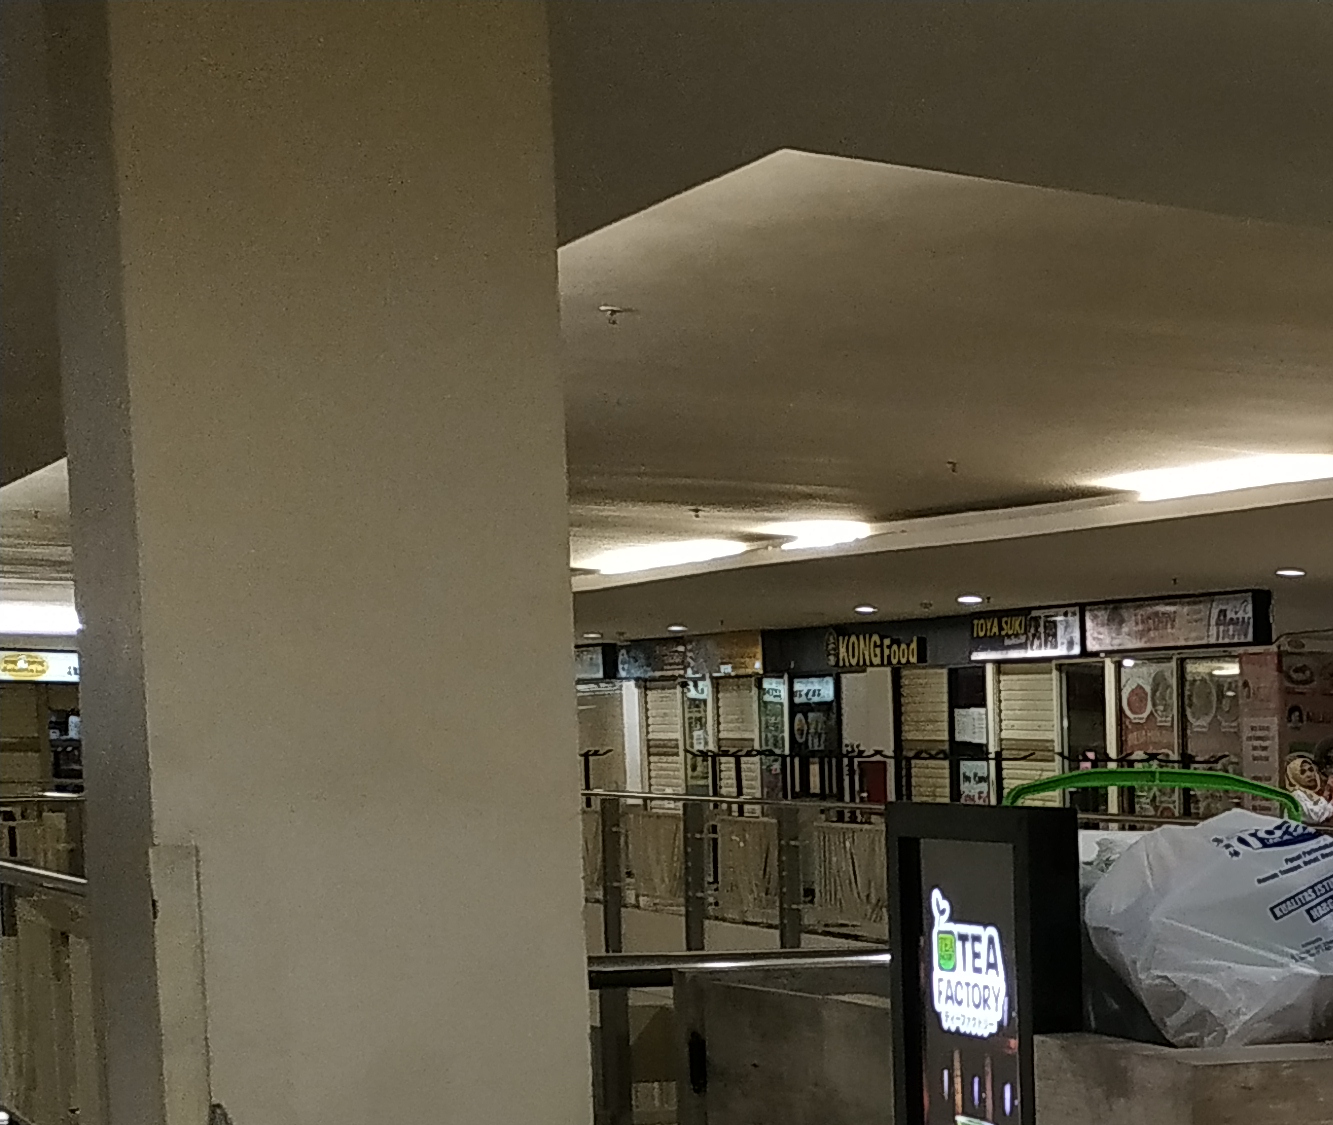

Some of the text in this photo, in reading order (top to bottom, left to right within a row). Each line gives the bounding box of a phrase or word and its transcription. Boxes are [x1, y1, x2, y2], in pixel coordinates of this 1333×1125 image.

[973, 615, 1026, 638] TOYA SUKI
[839, 634, 918, 667] KONG Food
[957, 933, 1000, 978] TEA
[937, 977, 1001, 1013] FACTORY
